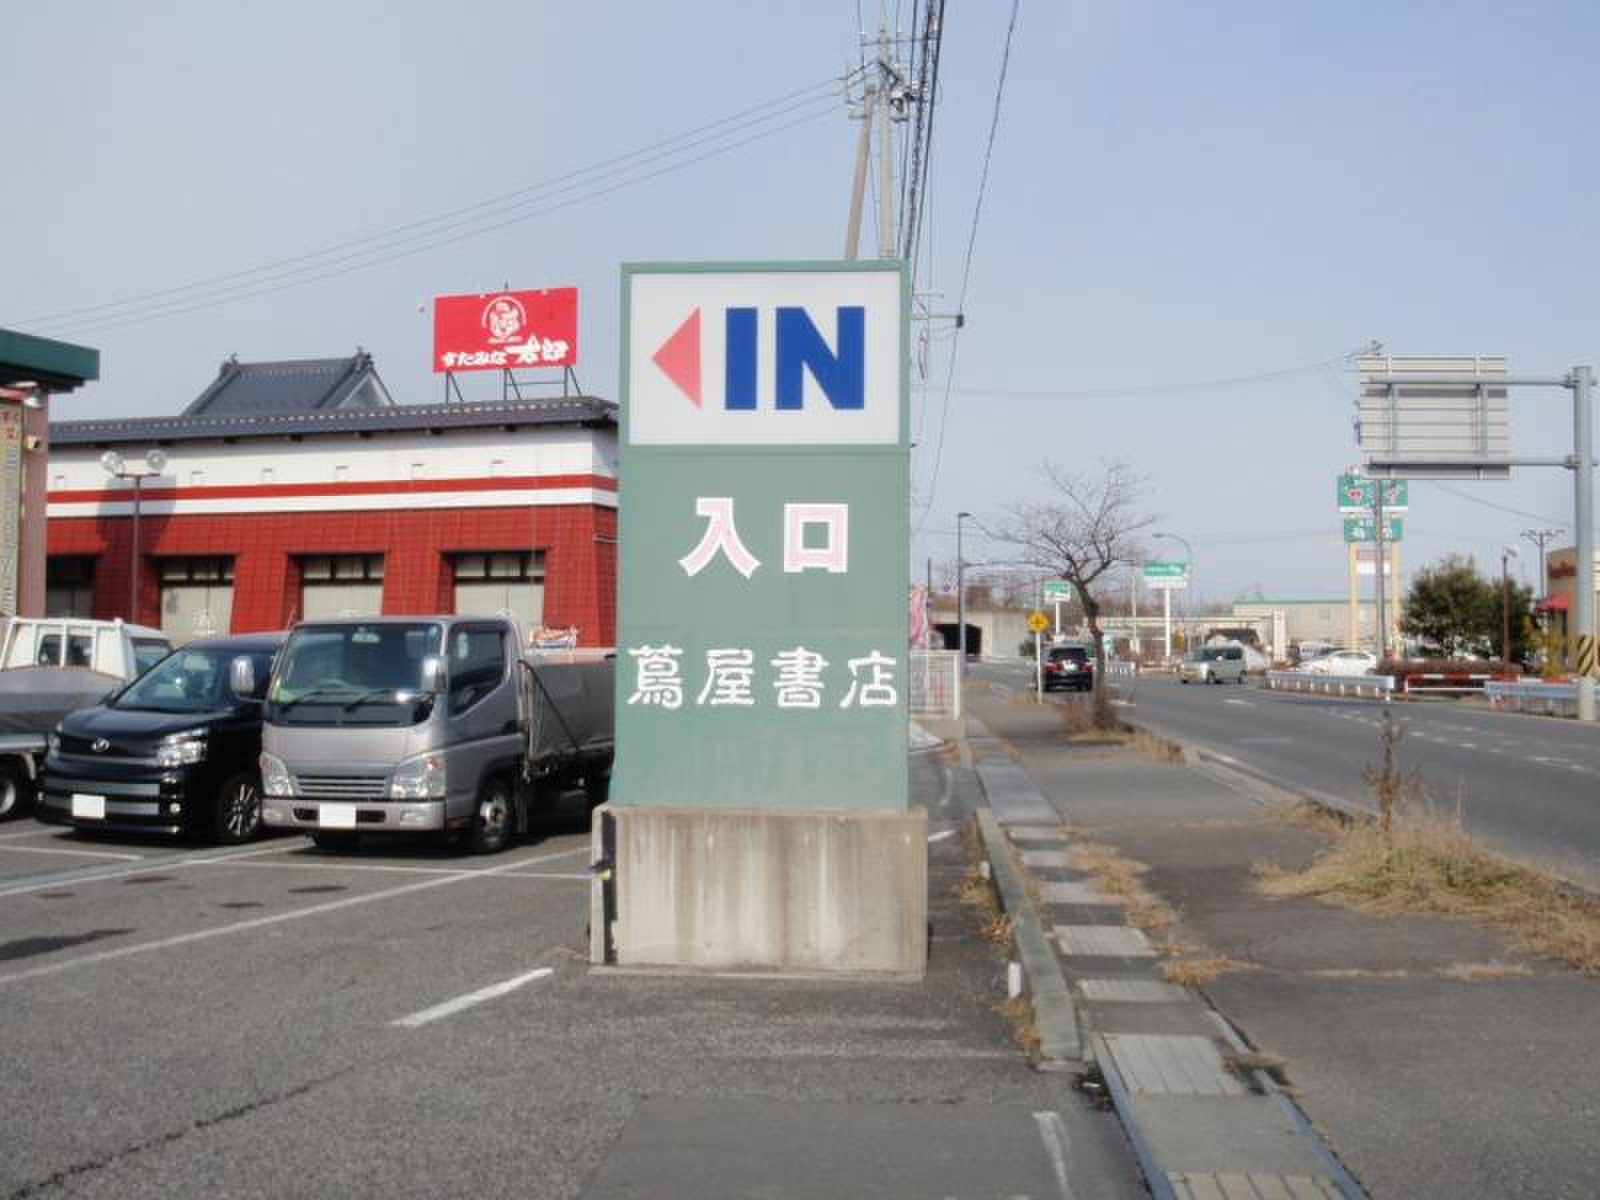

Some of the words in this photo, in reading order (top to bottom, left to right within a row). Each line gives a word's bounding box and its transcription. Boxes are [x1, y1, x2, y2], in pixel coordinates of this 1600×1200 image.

[725, 306, 865, 410] IN
[679, 497, 849, 578] 入口
[627, 645, 898, 709] 蔦屋書店
